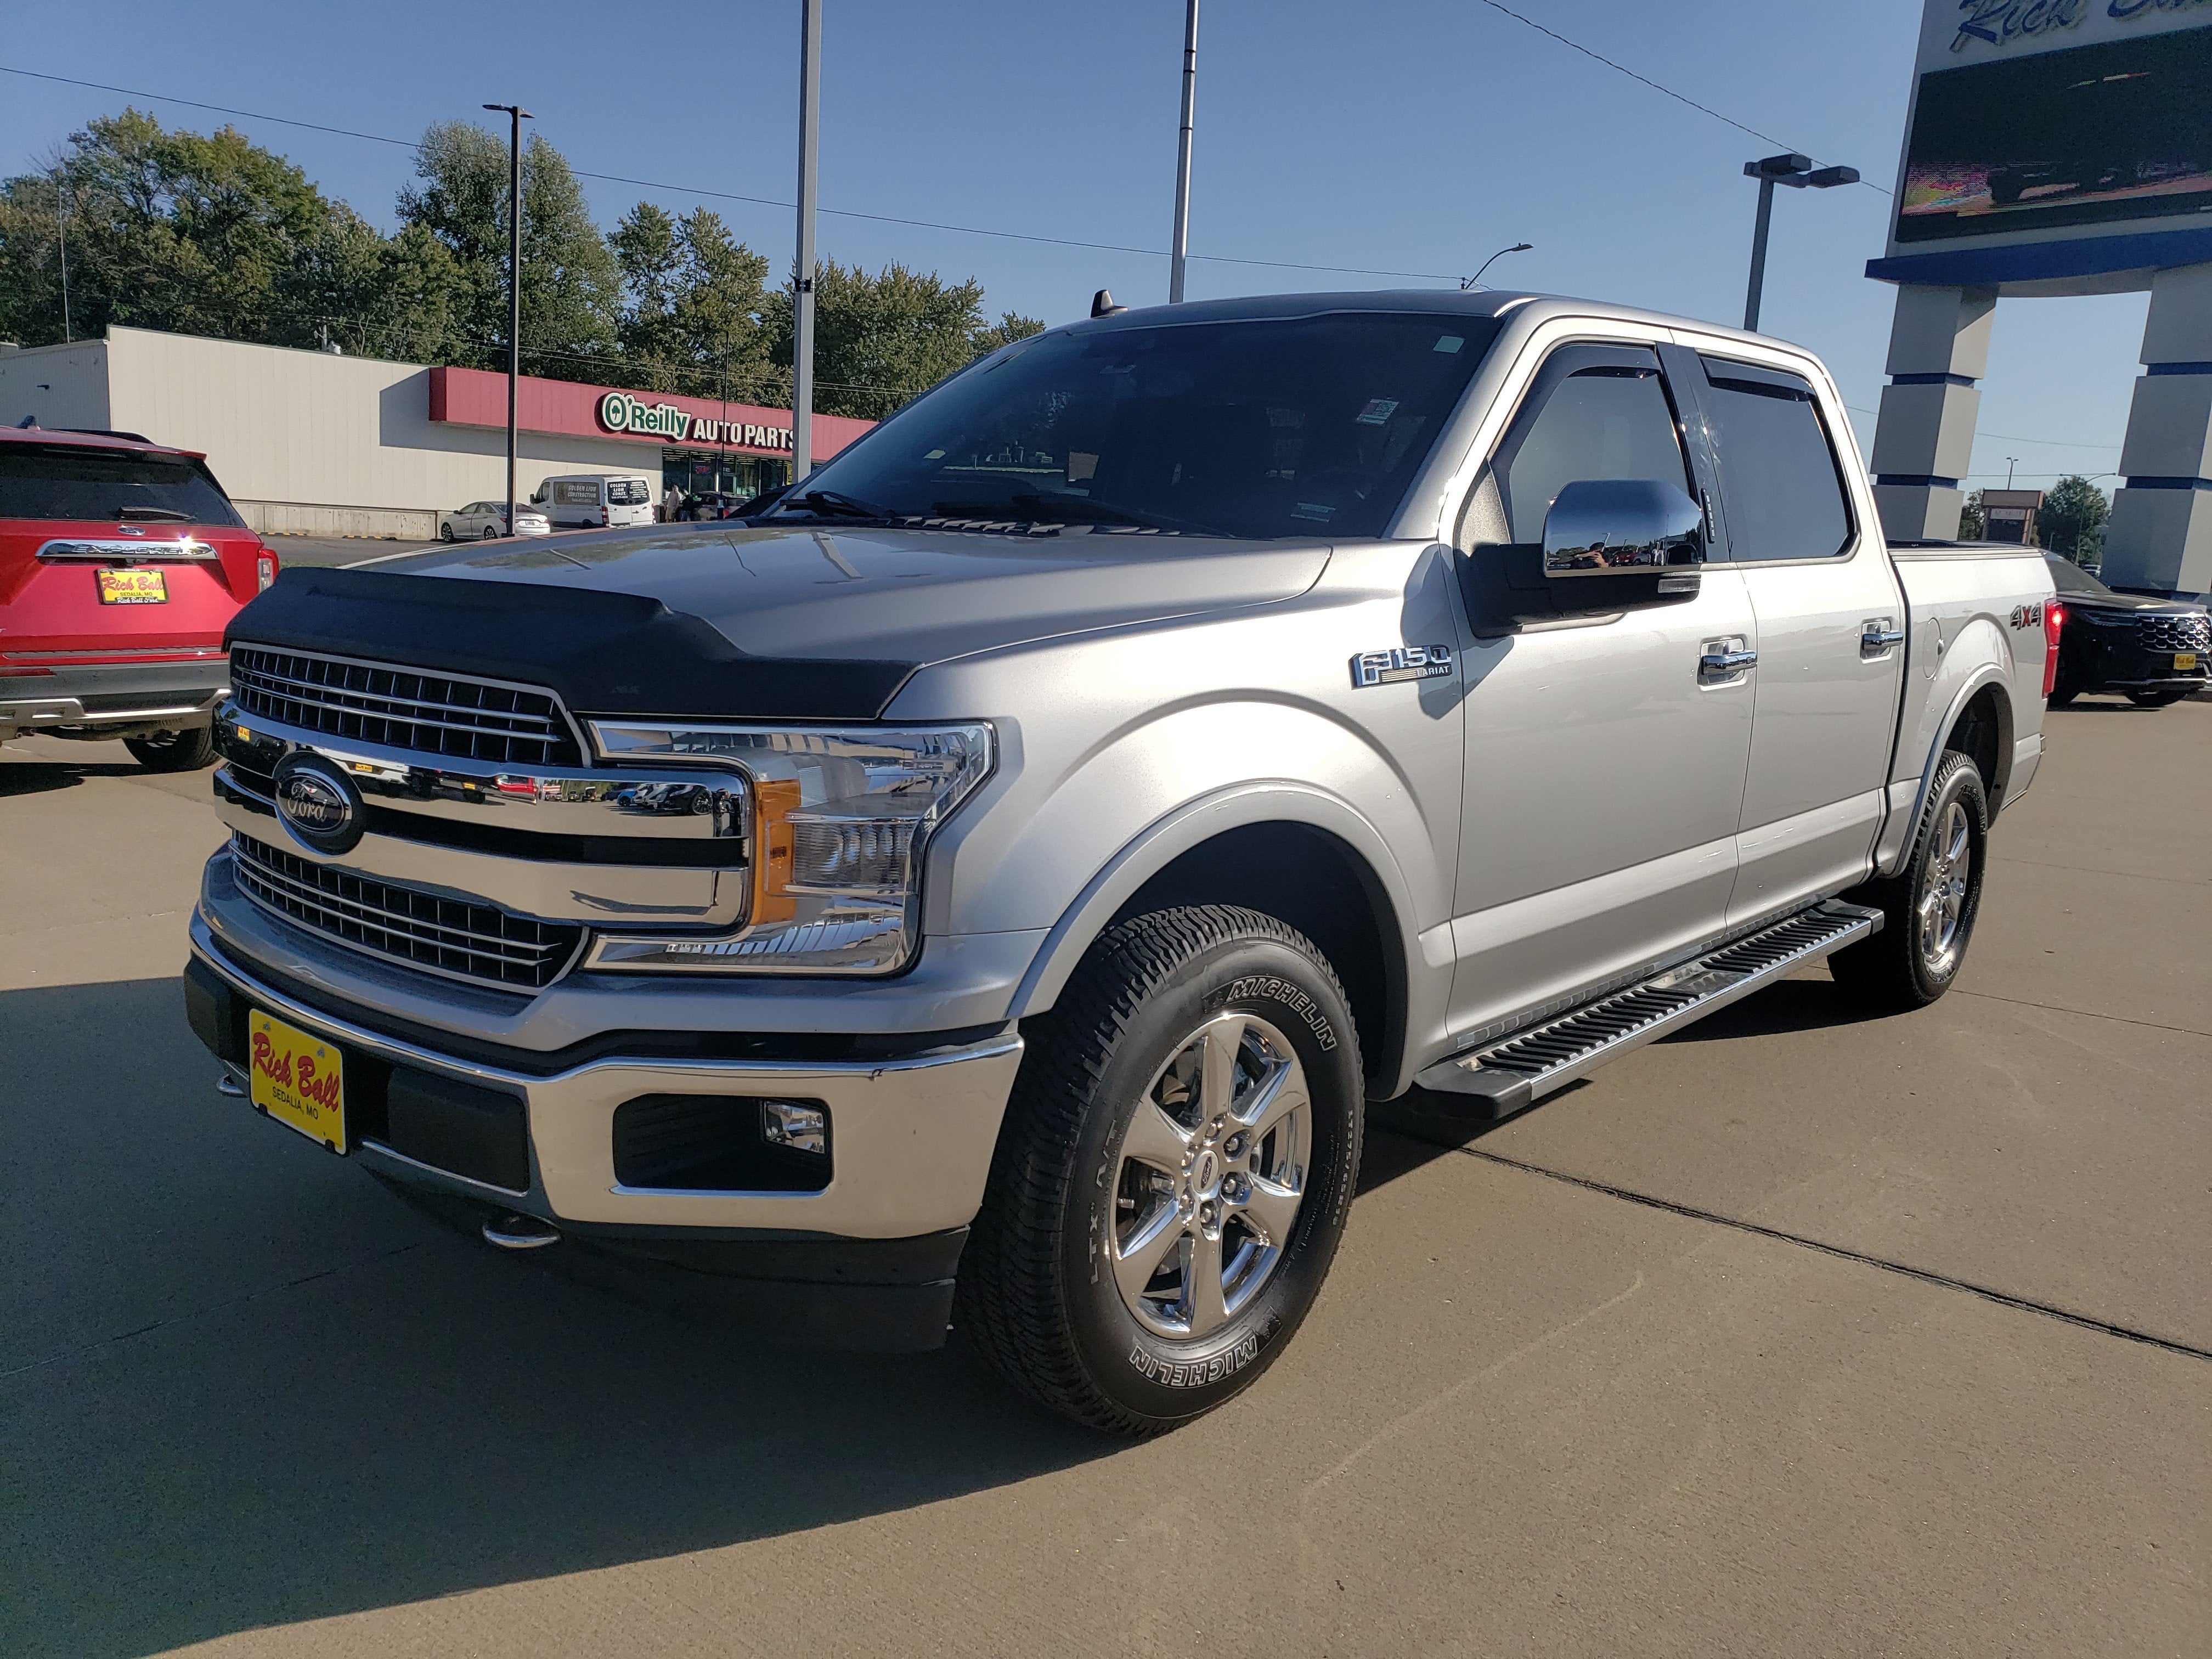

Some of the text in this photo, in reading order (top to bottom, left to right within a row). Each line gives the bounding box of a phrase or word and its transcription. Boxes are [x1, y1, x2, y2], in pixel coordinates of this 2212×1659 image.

[605, 394, 689, 438] O'Reilly
[693, 418, 742, 443] AUTO
[73, 544, 191, 555] EXPLORE
[101, 576, 163, 591] Rick Ball
[1416, 665, 1450, 676] LARIAT
[287, 778, 329, 823] Ford
[1225, 977, 1338, 1051] MICHELIN
[252, 1032, 340, 1113] Rick Ball
[306, 1103, 319, 1120] MO
[1128, 1333, 1258, 1387] MICHELIN
